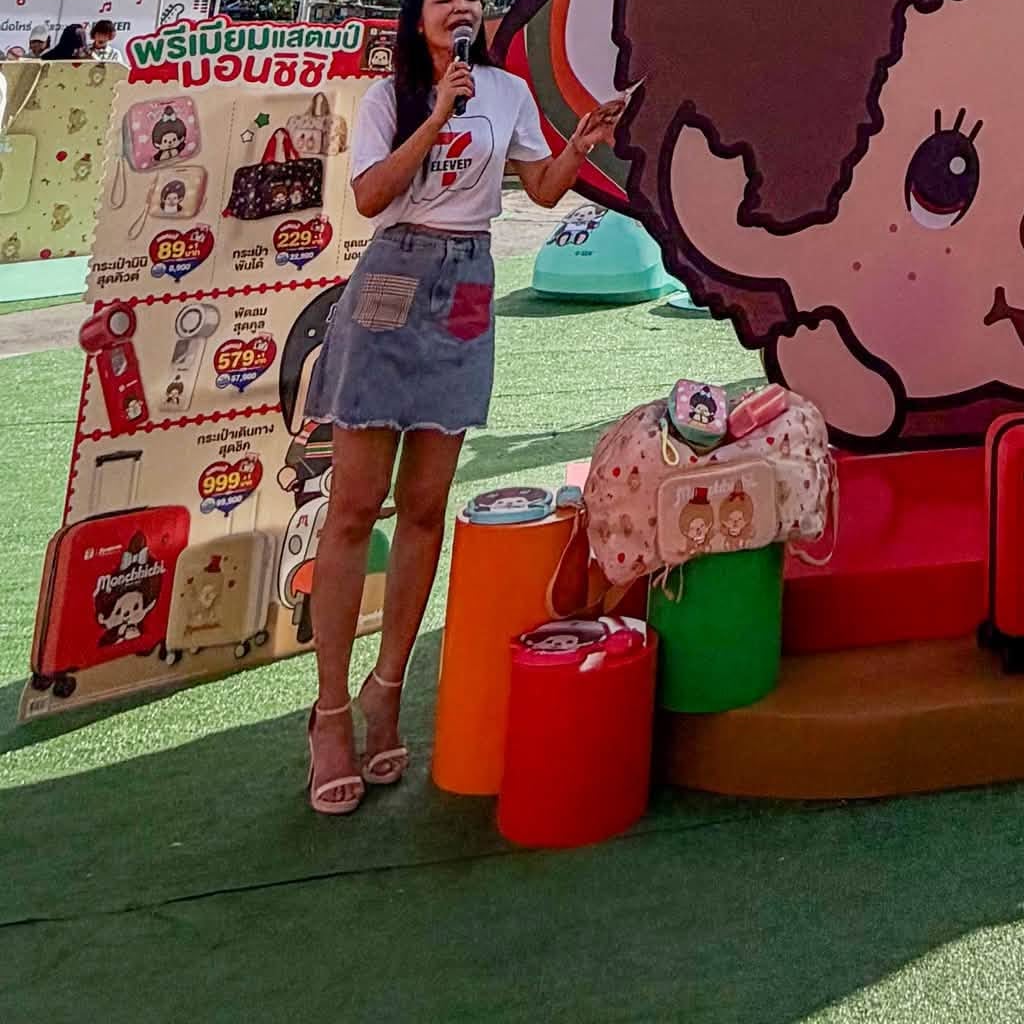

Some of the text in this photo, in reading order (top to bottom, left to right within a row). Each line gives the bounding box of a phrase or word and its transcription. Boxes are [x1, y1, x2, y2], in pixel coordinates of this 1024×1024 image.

[133, 24, 361, 65] พรีเมียมแสตมป์
[182, 52, 329, 88] มอนชิชิ
[157, 240, 186, 260] 89
[277, 230, 312, 249] 229
[217, 349, 255, 370] 579
[203, 471, 241, 495] 999
